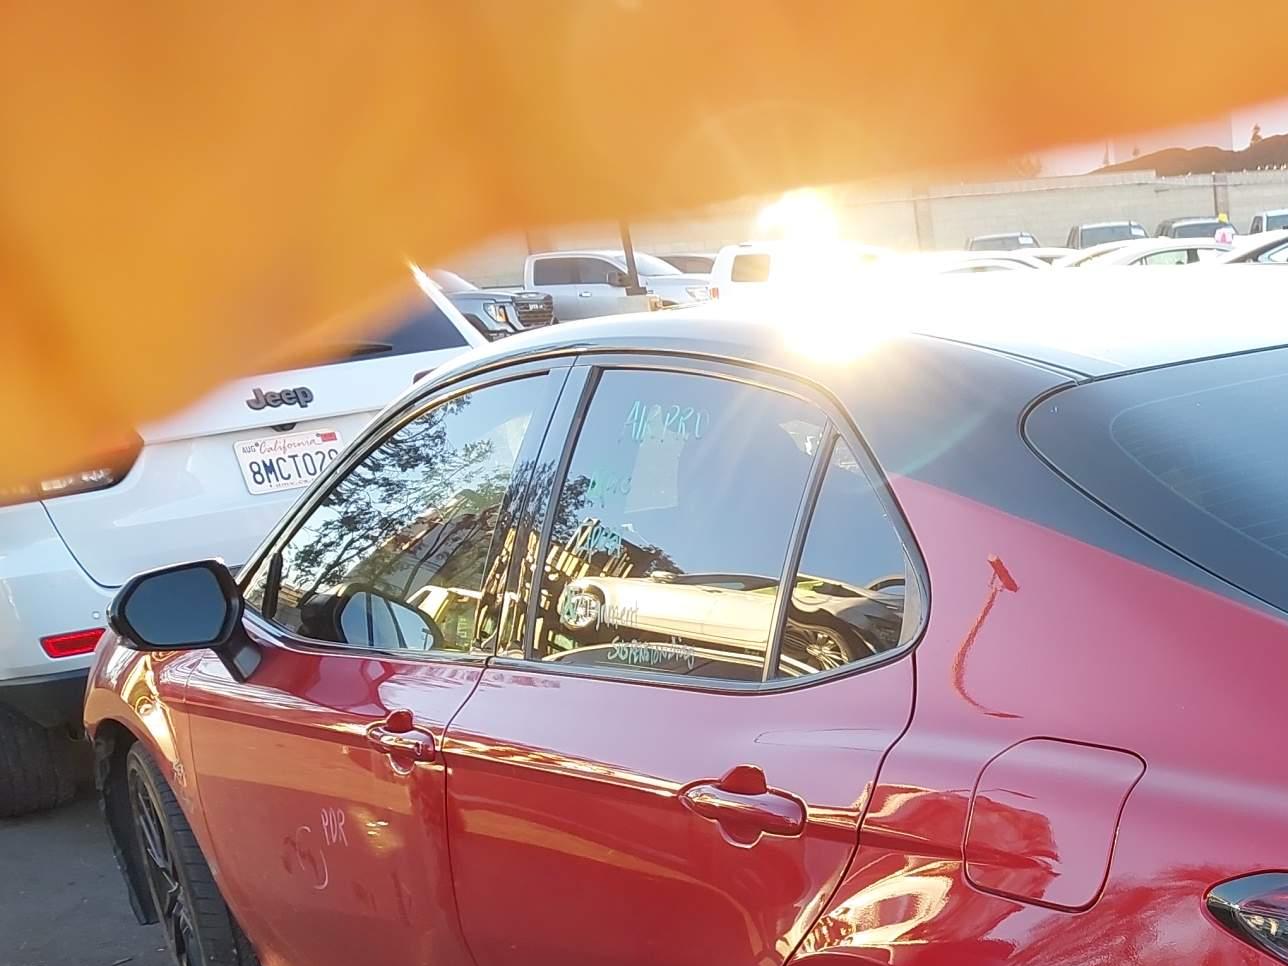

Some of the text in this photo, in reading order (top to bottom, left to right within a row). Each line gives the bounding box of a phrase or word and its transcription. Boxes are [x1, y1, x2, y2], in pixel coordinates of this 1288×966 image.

[246, 387, 314, 411] Jeep
[259, 439, 322, 455] California
[321, 808, 348, 846] PDR
